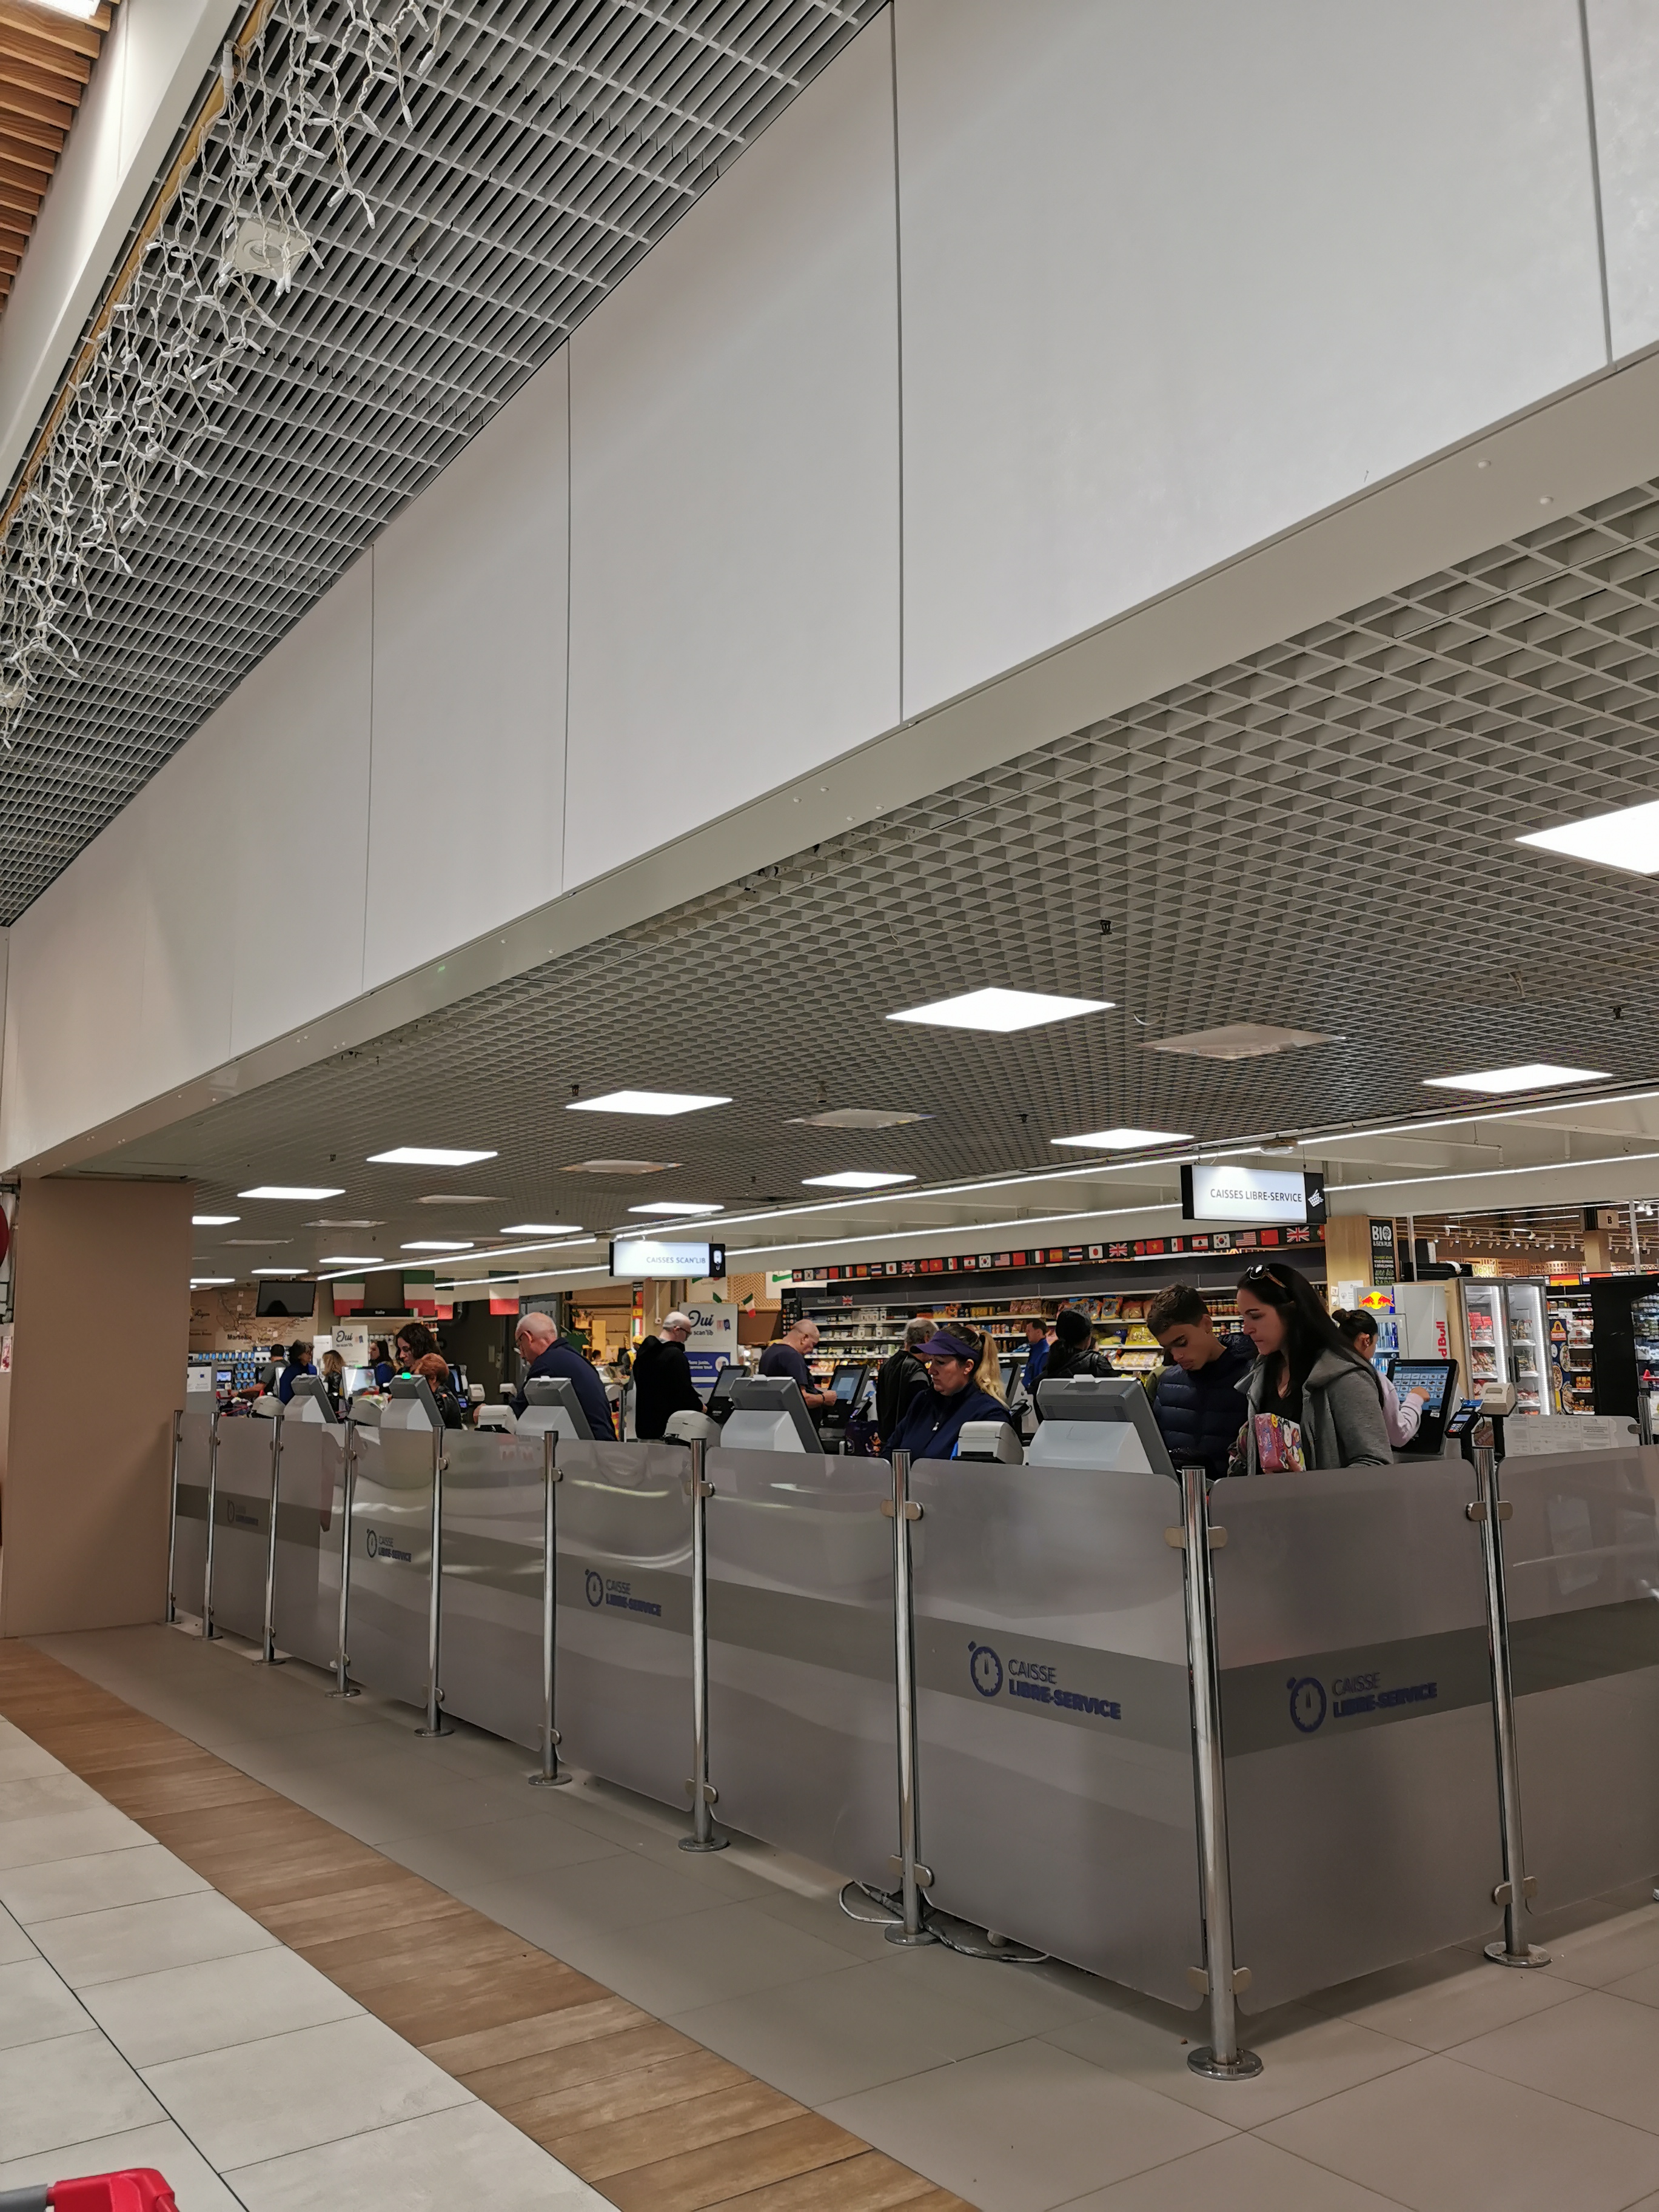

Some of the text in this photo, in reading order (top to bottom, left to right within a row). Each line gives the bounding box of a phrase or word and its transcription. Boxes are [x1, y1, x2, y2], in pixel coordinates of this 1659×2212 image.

[1210, 1188, 1302, 1202] CAISSES LIBRE-SERVICE
[1607, 1216, 1612, 1224] B
[1372, 1225, 1392, 1241] BIO
[688, 1310, 714, 1328] Oui
[336, 1330, 353, 1342] Oui
[1436, 1321, 1446, 1346] Bull
[1008, 1659, 1057, 1684] CAISSE
[1332, 1672, 1381, 1696] CAISSE
[1008, 1678, 1122, 1720] LIBRE-SERVICE
